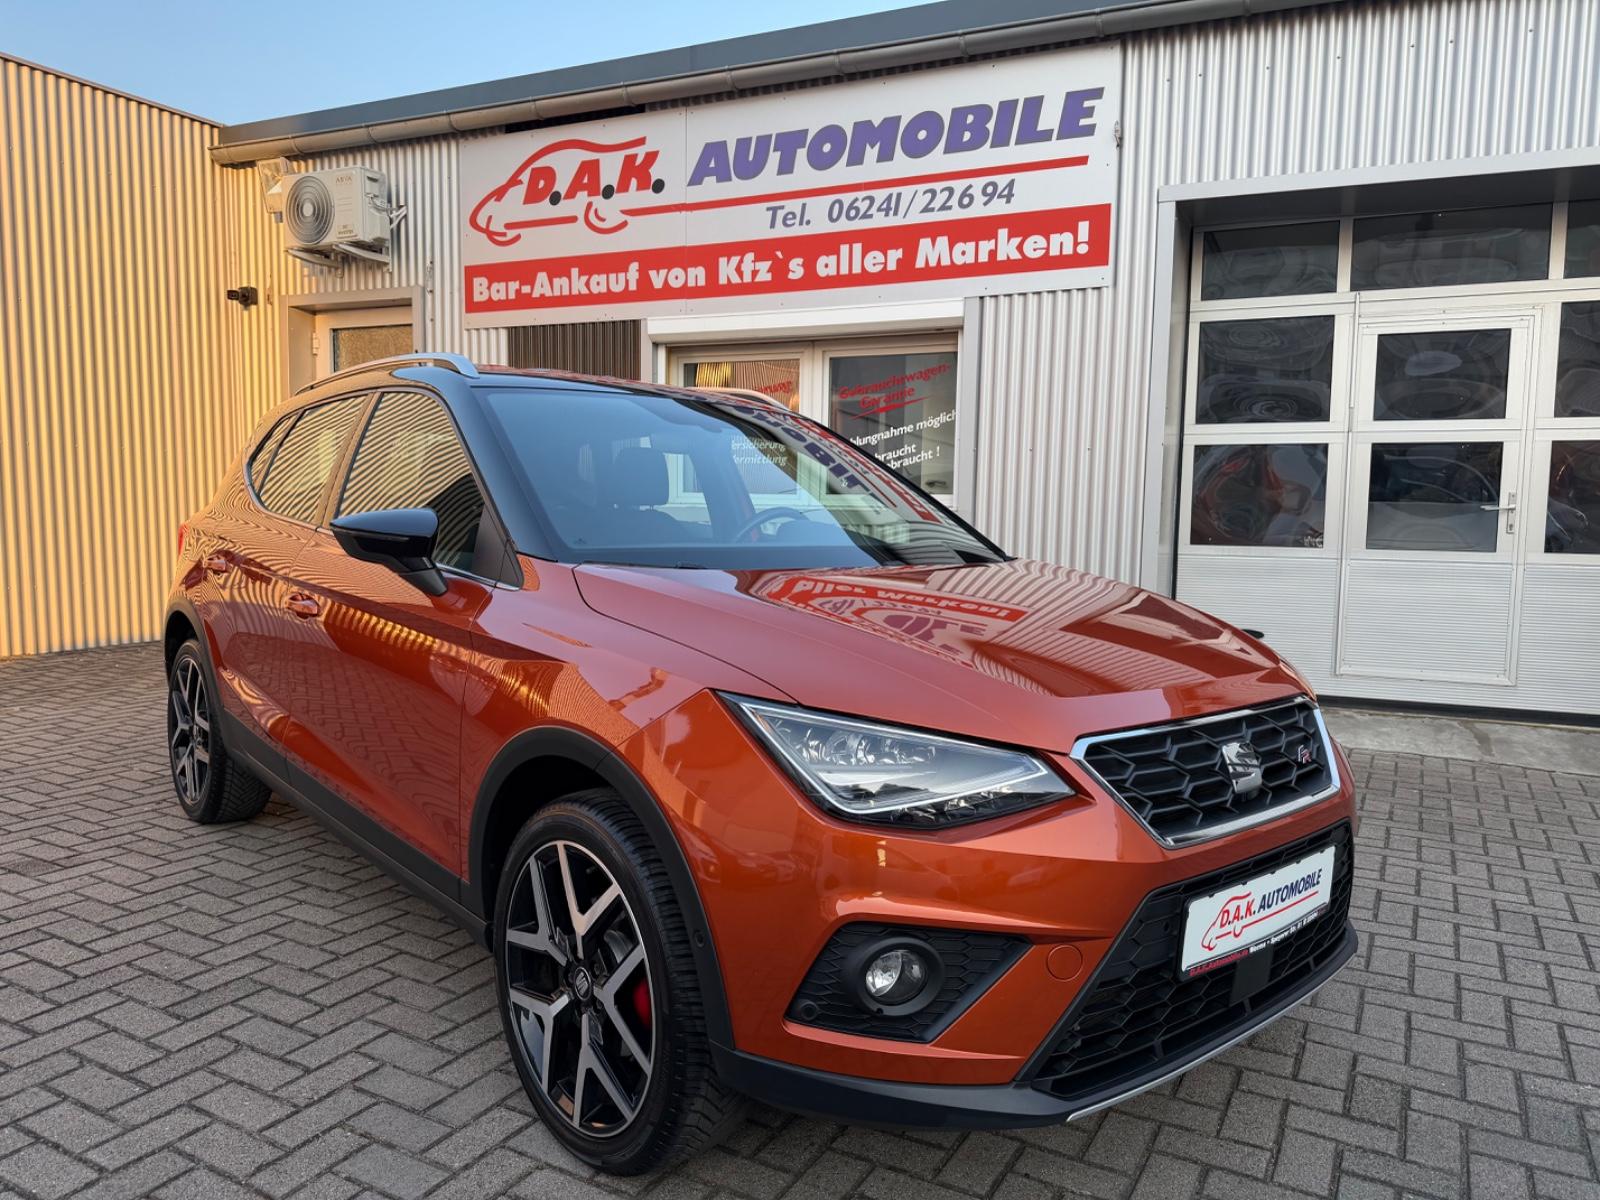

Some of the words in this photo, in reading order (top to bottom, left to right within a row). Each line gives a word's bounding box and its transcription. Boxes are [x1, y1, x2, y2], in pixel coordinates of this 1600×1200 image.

[523, 150, 665, 206] D.A.K.
[687, 86, 1104, 187] AUTOMOBILE
[766, 202, 811, 229] Tel.
[473, 261, 640, 303] Bar-Ankauf
[648, 265, 706, 289] von
[816, 242, 903, 278] aller
[915, 220, 1090, 269] Marken!
[1220, 898, 1256, 928] D.A.K.
[1257, 868, 1322, 913] AUTOMOBILE
